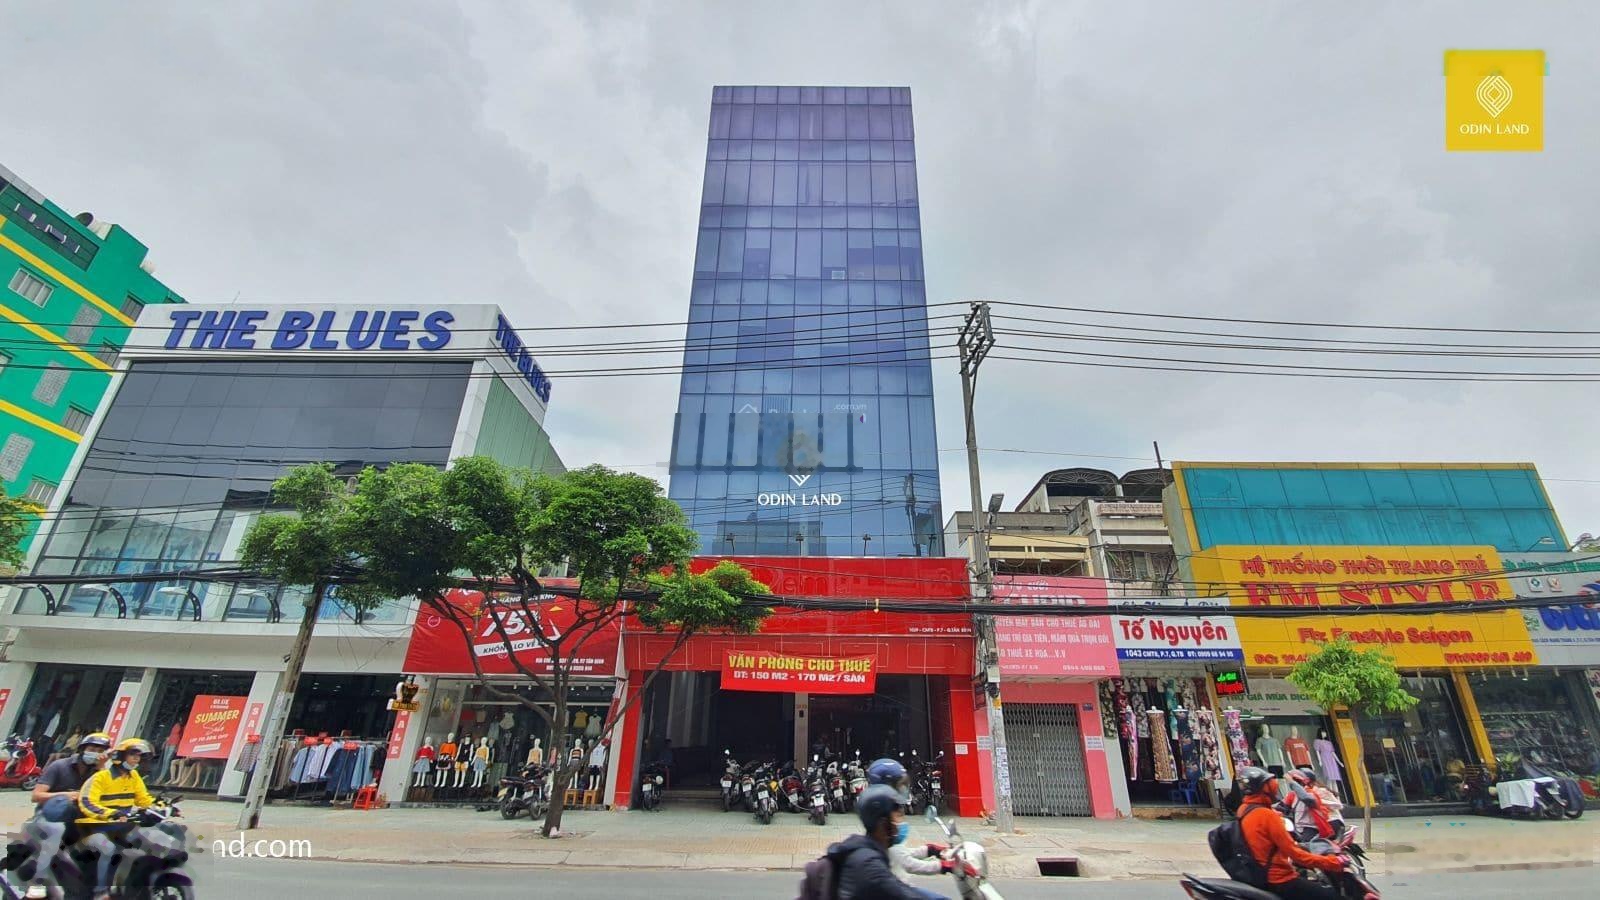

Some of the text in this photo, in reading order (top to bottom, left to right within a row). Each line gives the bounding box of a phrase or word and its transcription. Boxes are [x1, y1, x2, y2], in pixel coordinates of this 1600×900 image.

[164, 310, 456, 351] THE BLUES
[496, 313, 521, 363] THE
[1268, 552, 1337, 574] THỐNG
[1388, 559, 1455, 575] TRANG
[1119, 617, 1229, 647] Tố Nguyên
[1406, 625, 1474, 647] Saigon
[728, 652, 755, 669] VĂN
[758, 654, 804, 671] PHÒNG
[807, 657, 835, 672] CHO
[751, 672, 769, 680] 150
[771, 672, 788, 681] M2
[797, 673, 816, 681] 170
[818, 674, 835, 682] M2
[195, 710, 240, 724] SUMMER
